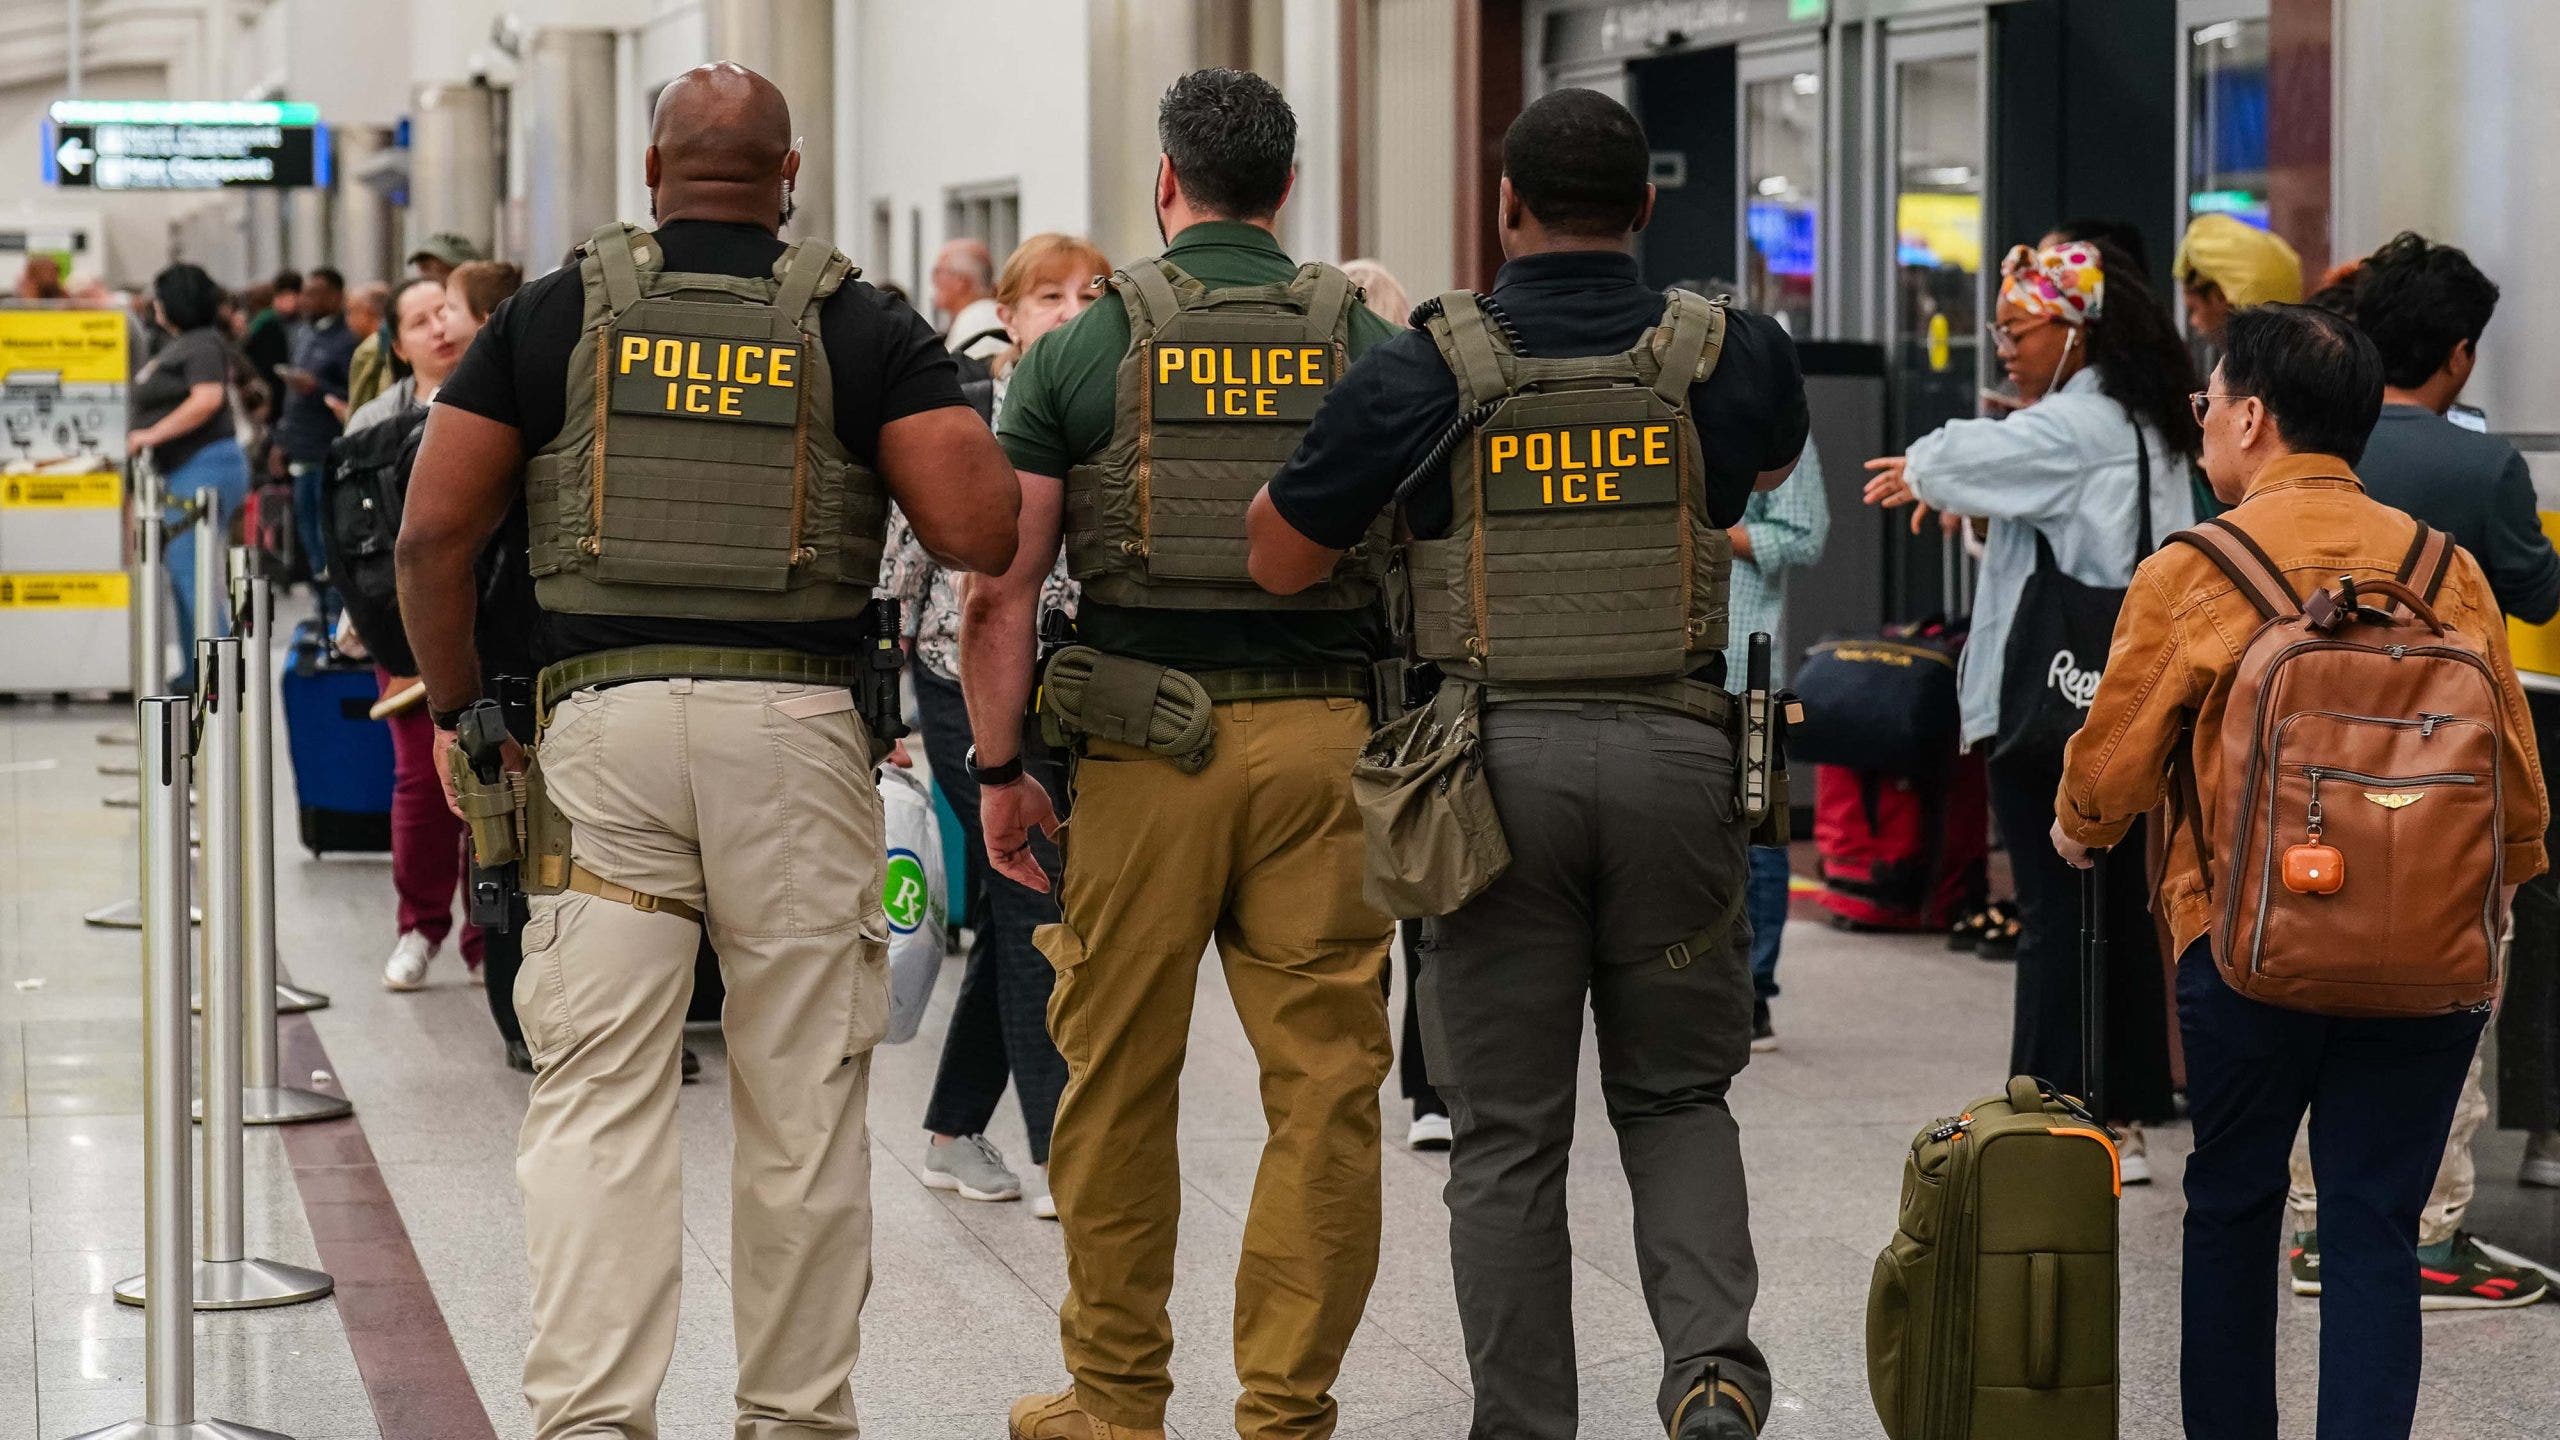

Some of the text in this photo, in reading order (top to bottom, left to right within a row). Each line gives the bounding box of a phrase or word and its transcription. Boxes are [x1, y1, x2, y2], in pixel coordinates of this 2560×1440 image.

[620, 336, 797, 388] POLICE
[1159, 347, 1324, 385] POLICE
[666, 382, 744, 416] ICE
[1206, 388, 1278, 416] ICE
[1491, 426, 1670, 473] POLICE
[1542, 472, 1621, 504] ICE
